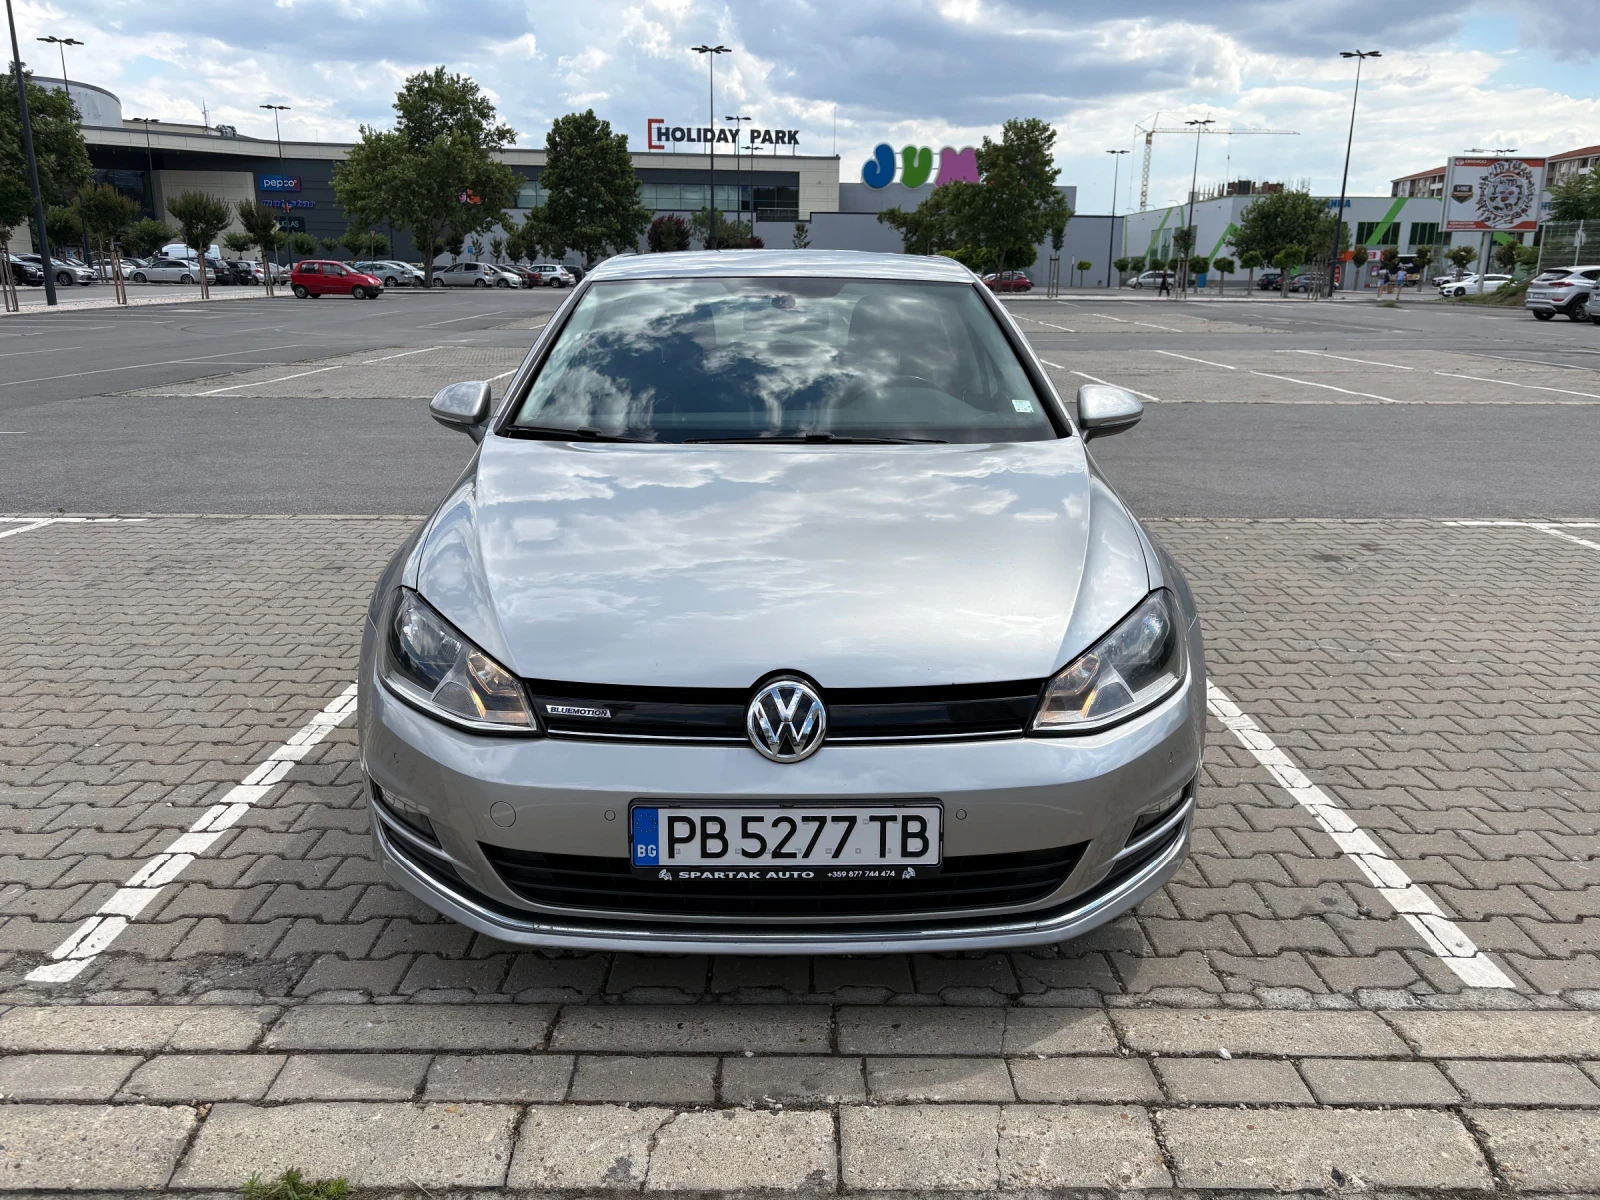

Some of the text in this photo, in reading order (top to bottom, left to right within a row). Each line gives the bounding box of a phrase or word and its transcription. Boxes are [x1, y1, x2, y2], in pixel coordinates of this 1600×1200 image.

[656, 127, 799, 144] HOLIDAY PARK
[862, 142, 981, 189] JUM
[263, 179, 295, 188] pepco
[550, 706, 608, 716] BLUEMOTION
[667, 815, 929, 859] PB 5277 TB
[637, 844, 657, 857] BG
[678, 871, 815, 879] SPARTAK AUTO
[827, 870, 847, 878] +359
